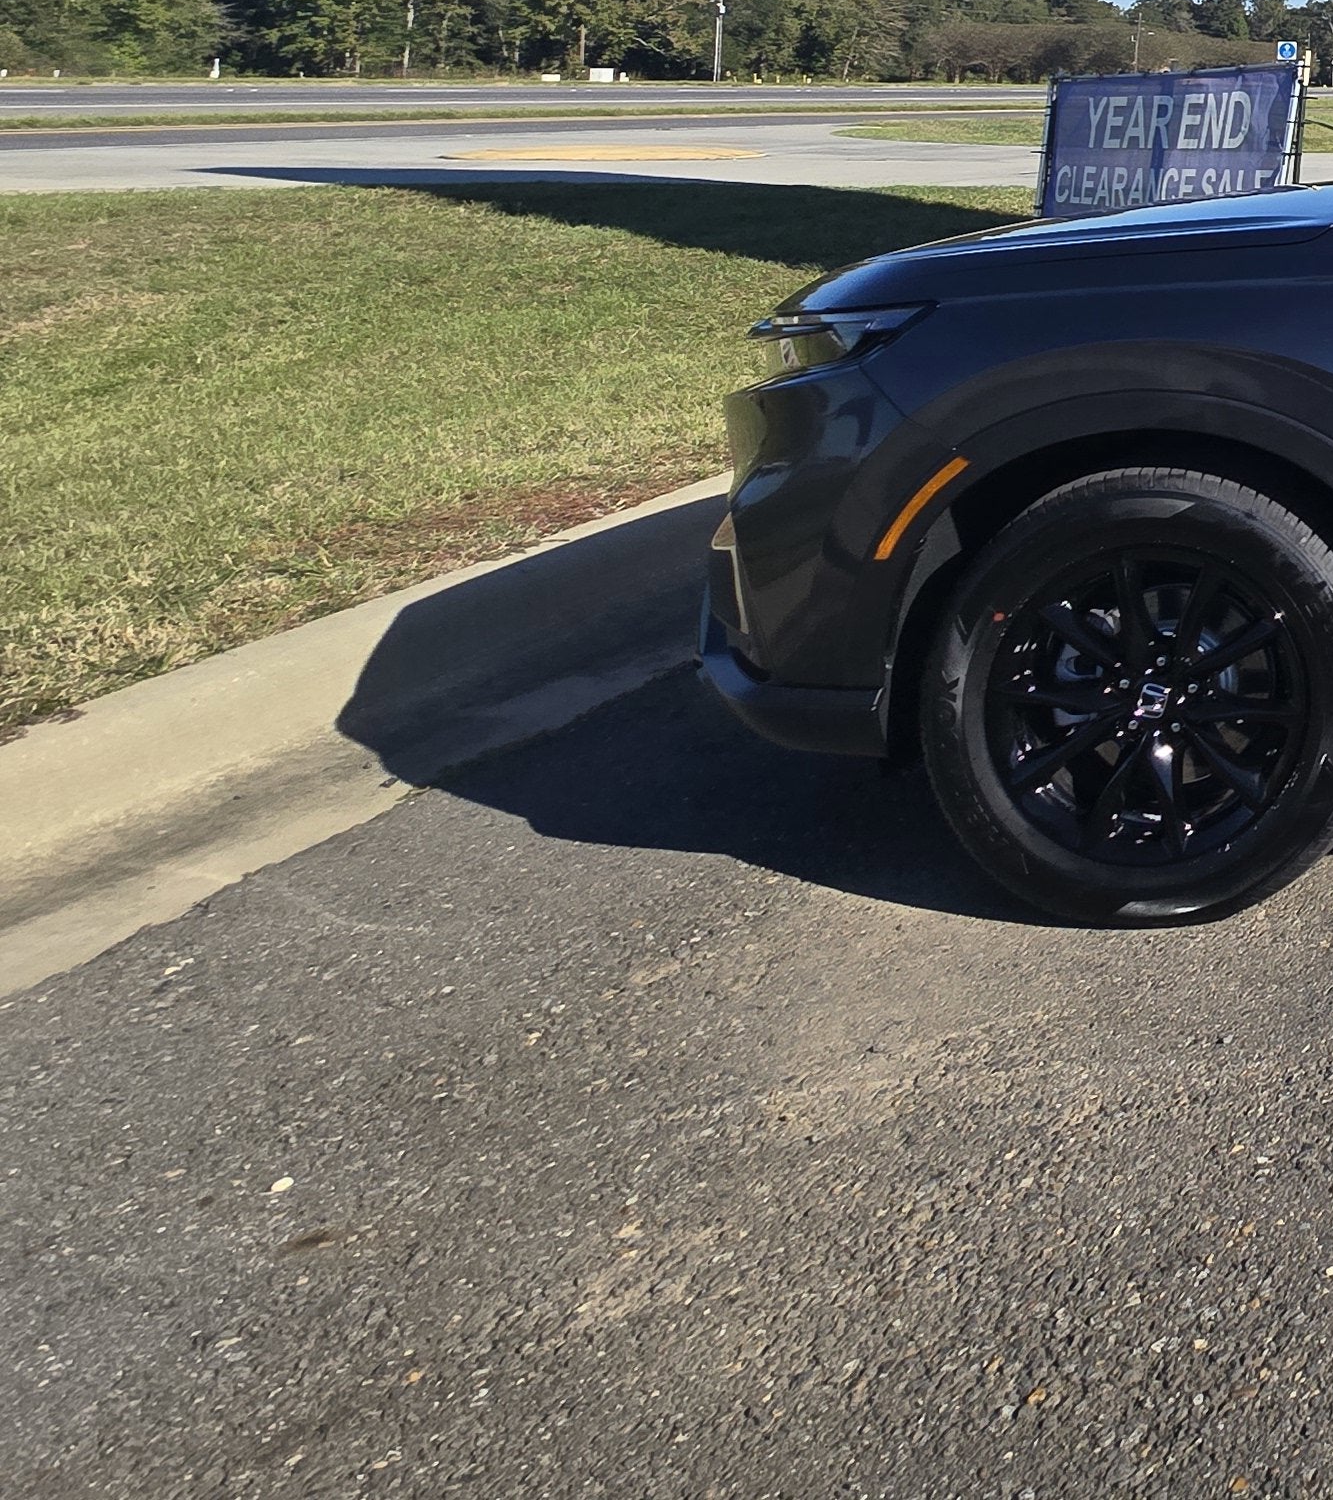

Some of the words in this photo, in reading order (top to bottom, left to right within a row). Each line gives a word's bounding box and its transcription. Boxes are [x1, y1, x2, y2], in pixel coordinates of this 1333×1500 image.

[1088, 95, 1173, 149] YEAR
[1177, 91, 1251, 149] END
[1055, 165, 1197, 208] CLEARANCE
